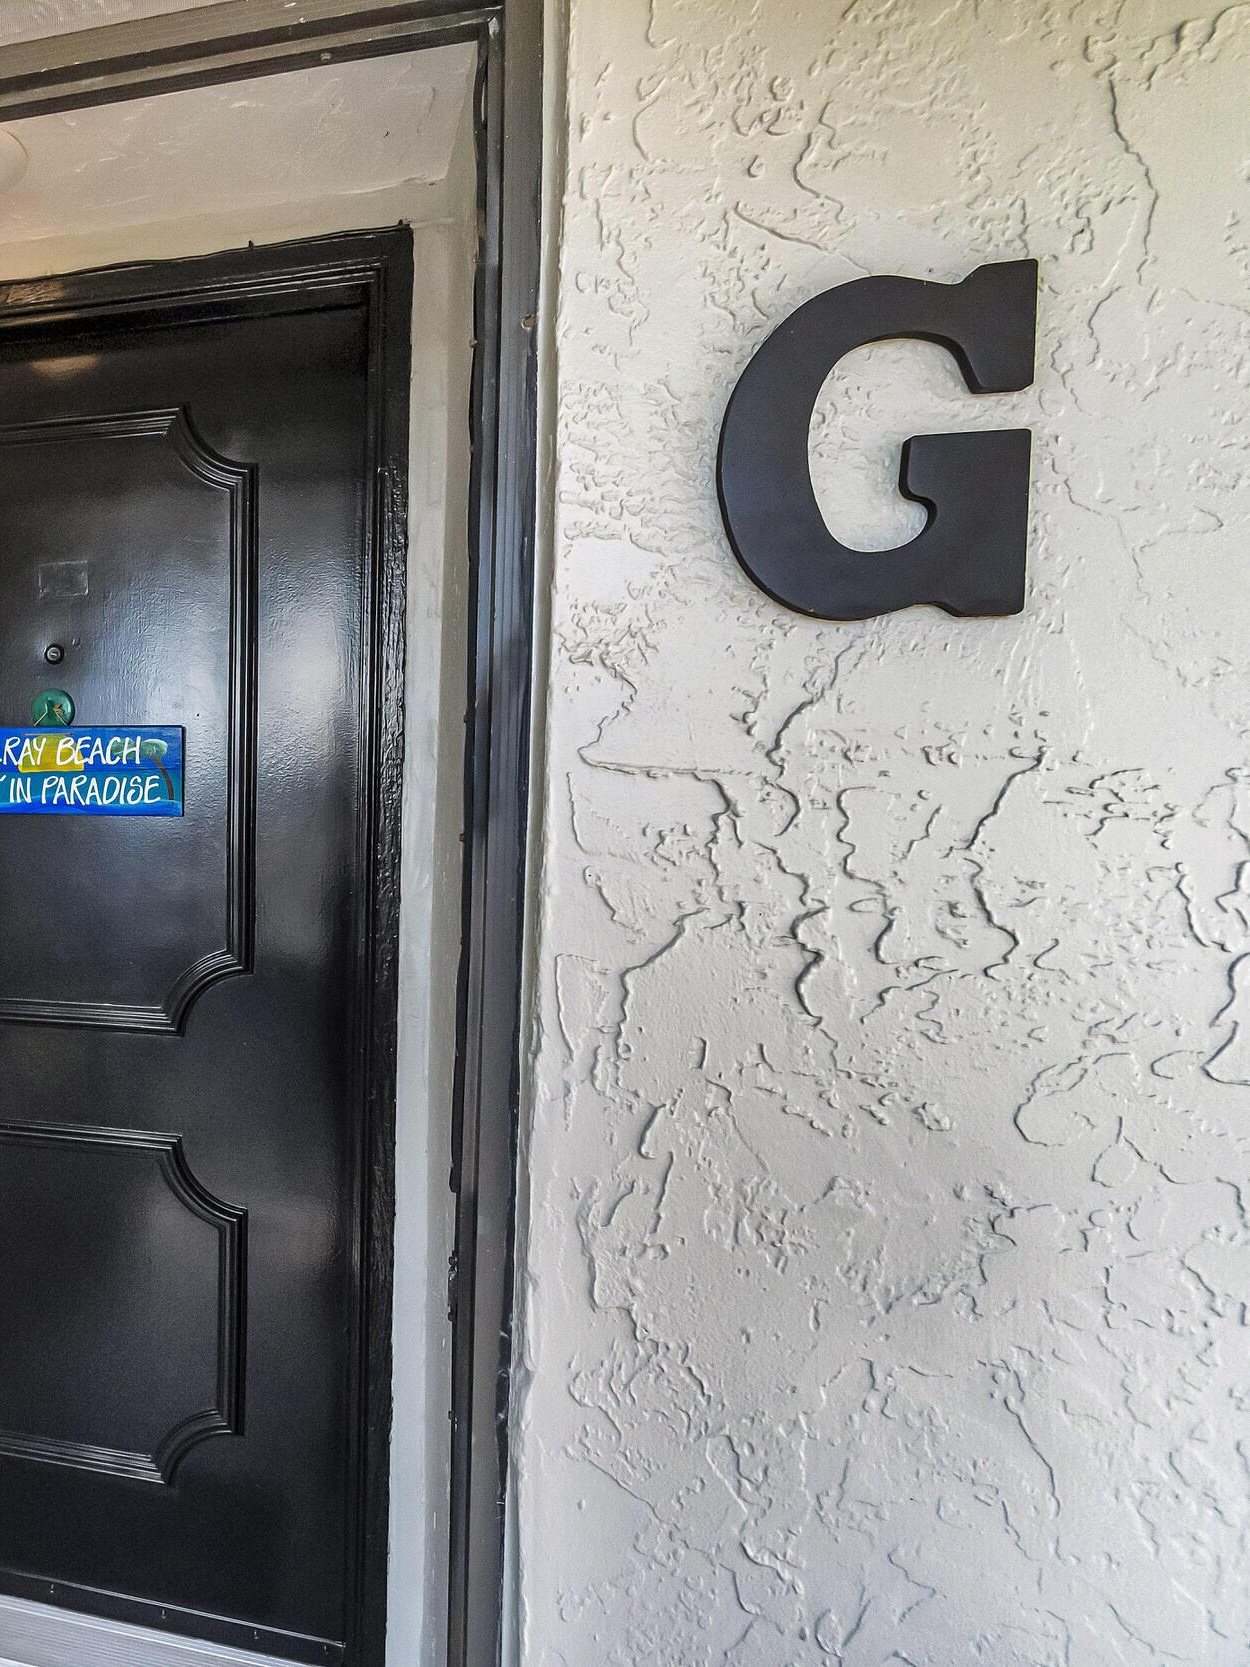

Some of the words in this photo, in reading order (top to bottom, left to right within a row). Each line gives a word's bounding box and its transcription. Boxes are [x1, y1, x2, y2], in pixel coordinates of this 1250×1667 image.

[716, 258, 1038, 621] G
[56, 736, 141, 766] BEACH
[10, 775, 32, 803] IN
[41, 774, 161, 806] PARADISE
